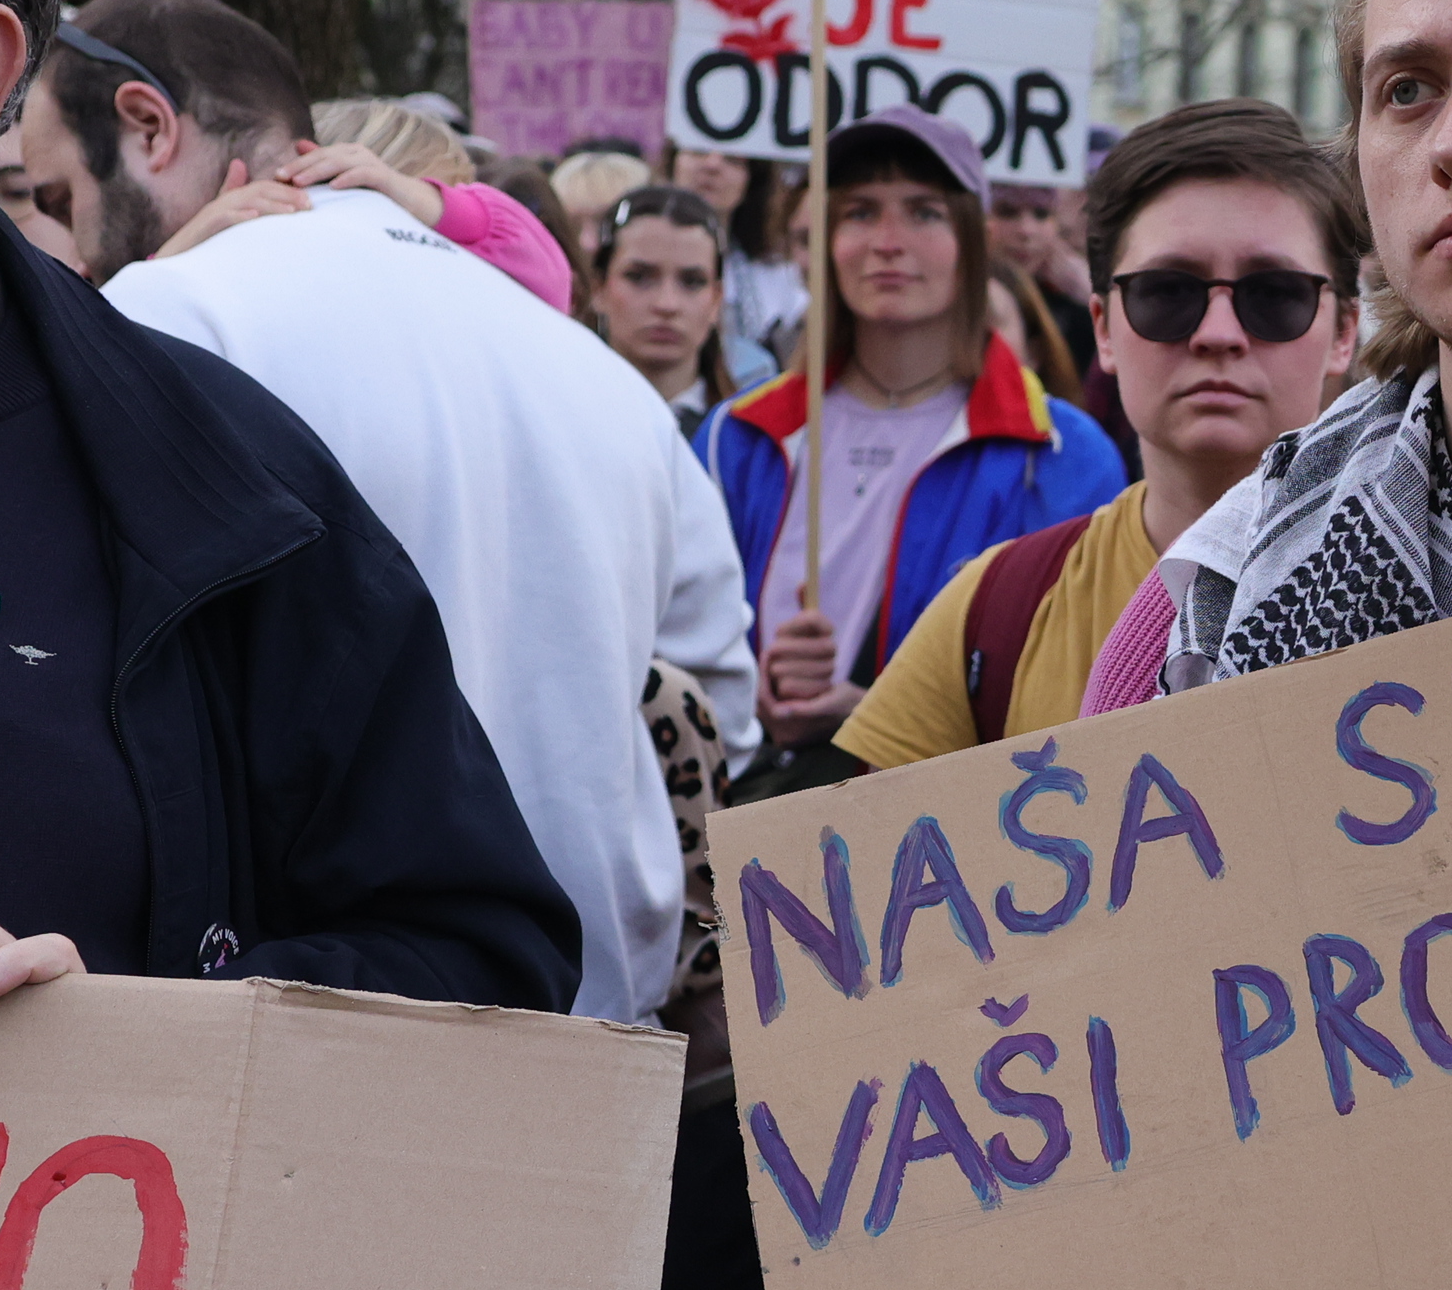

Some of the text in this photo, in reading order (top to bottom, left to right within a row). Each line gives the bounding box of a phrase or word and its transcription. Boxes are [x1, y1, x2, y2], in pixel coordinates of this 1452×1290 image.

[211, 928, 241, 956] MY VOICE
[739, 736, 1230, 1027] NAŠA
[747, 993, 1131, 1251] VAŠI
